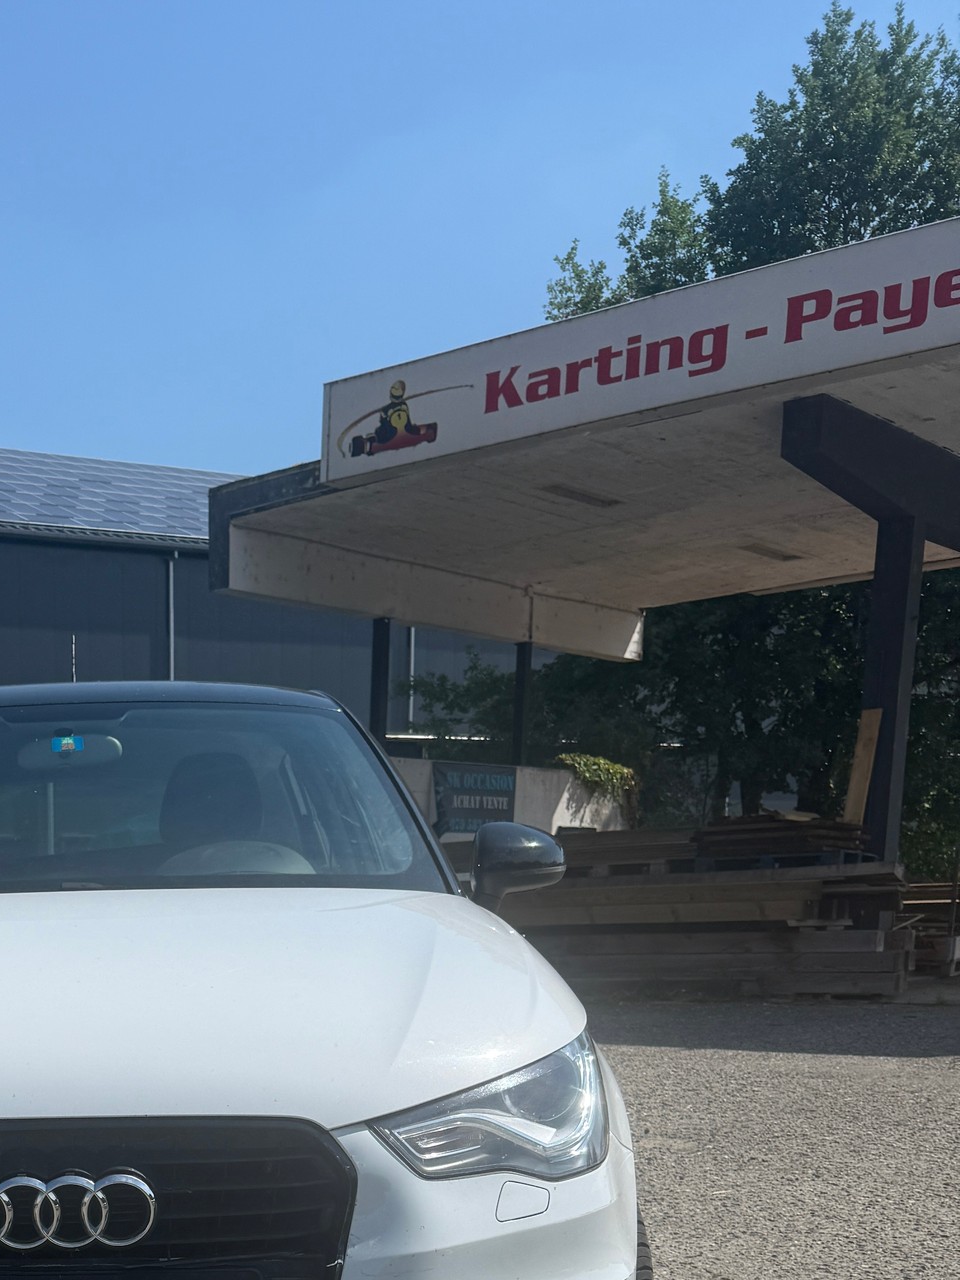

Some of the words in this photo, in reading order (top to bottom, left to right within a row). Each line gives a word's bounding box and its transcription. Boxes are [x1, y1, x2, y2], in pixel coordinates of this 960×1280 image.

[484, 324, 730, 414] Karting
[451, 795, 481, 809] ACHAT
[482, 796, 509, 810] VENTE
